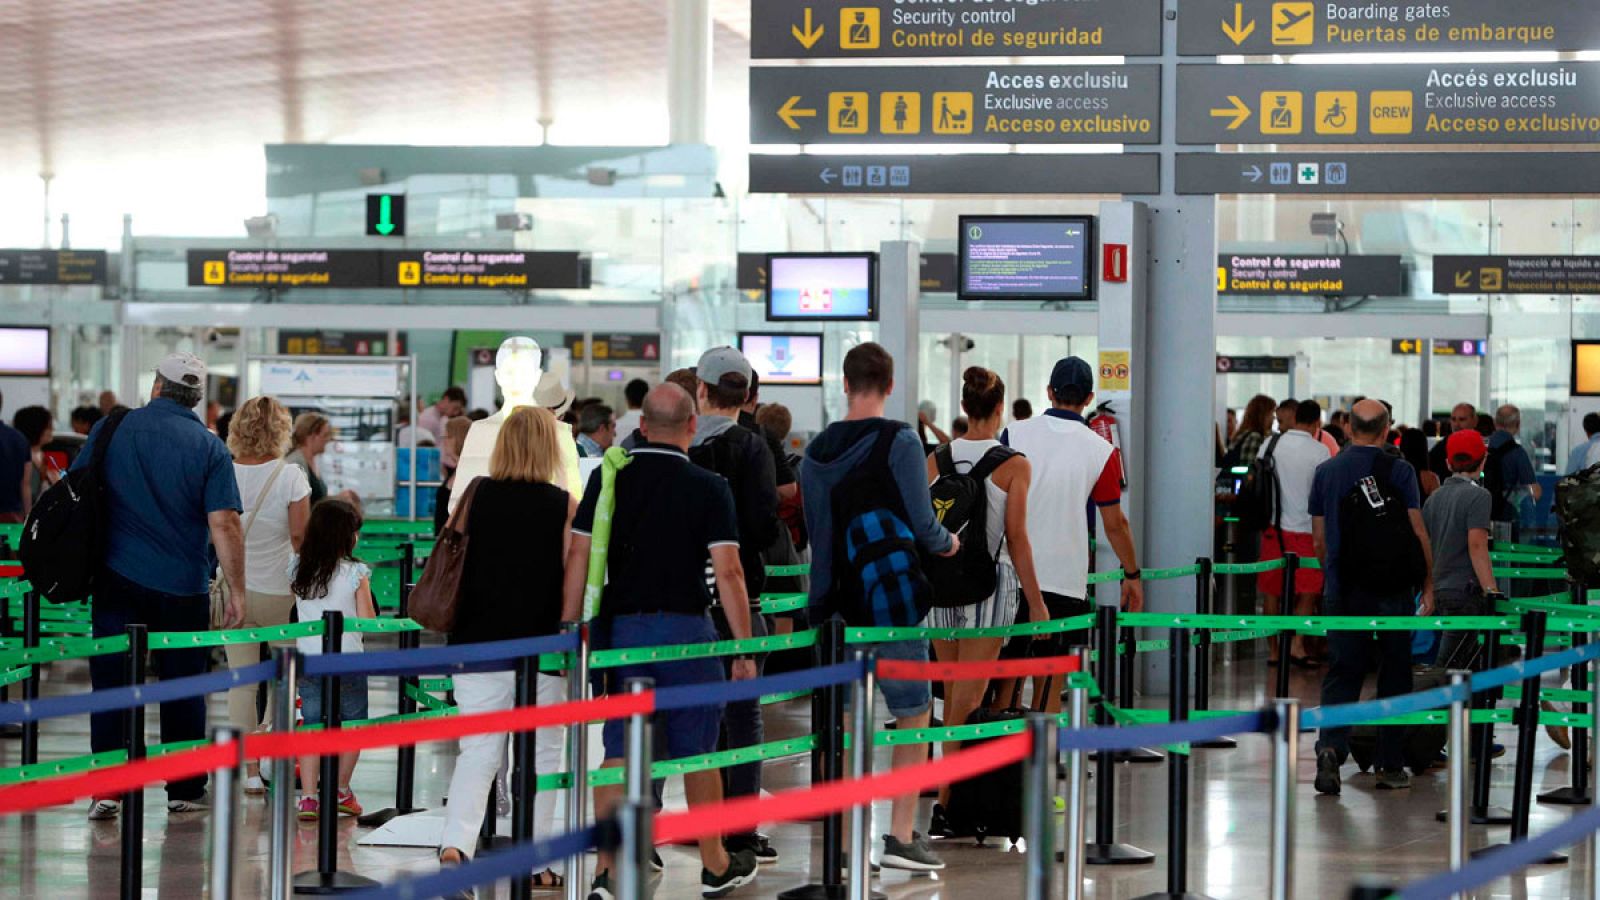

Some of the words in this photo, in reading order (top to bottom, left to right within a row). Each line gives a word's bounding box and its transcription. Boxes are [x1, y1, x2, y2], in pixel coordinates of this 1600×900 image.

[892, 8, 955, 26] Security
[961, 7, 1016, 24] control
[1327, 3, 1399, 22] Boarding
[1405, 4, 1450, 22] gates
[892, 28, 963, 47] Control
[971, 28, 995, 46] de
[1003, 26, 1103, 49] seguridad
[1327, 23, 1407, 43] Puertas
[1415, 24, 1440, 42] de
[1448, 23, 1555, 44] embarque
[985, 71, 1045, 89] Acces
[1049, 70, 1129, 89] exclusiu
[1426, 68, 1489, 87] Accés
[1493, 67, 1577, 87] exclusiu
[984, 94, 1053, 110] Exclusive
[1056, 97, 1109, 110] access
[1424, 92, 1497, 109] Exclusive
[1501, 94, 1556, 109] access
[1373, 106, 1410, 119] CREW
[1425, 112, 1500, 132] Acceso
[1504, 112, 1600, 132] exclusivo
[984, 114, 1056, 133] Acceso
[1060, 113, 1150, 133] exclusivo
[1231, 256, 1271, 268] Control
[1273, 257, 1287, 268] de
[1290, 258, 1341, 270] seguretat
[1231, 268, 1265, 279] Security
[1267, 269, 1297, 279] control
[1231, 279, 1271, 291] Control
[1273, 279, 1287, 290] de
[1290, 279, 1344, 293] seguridad
[644, 344, 656, 358] A
